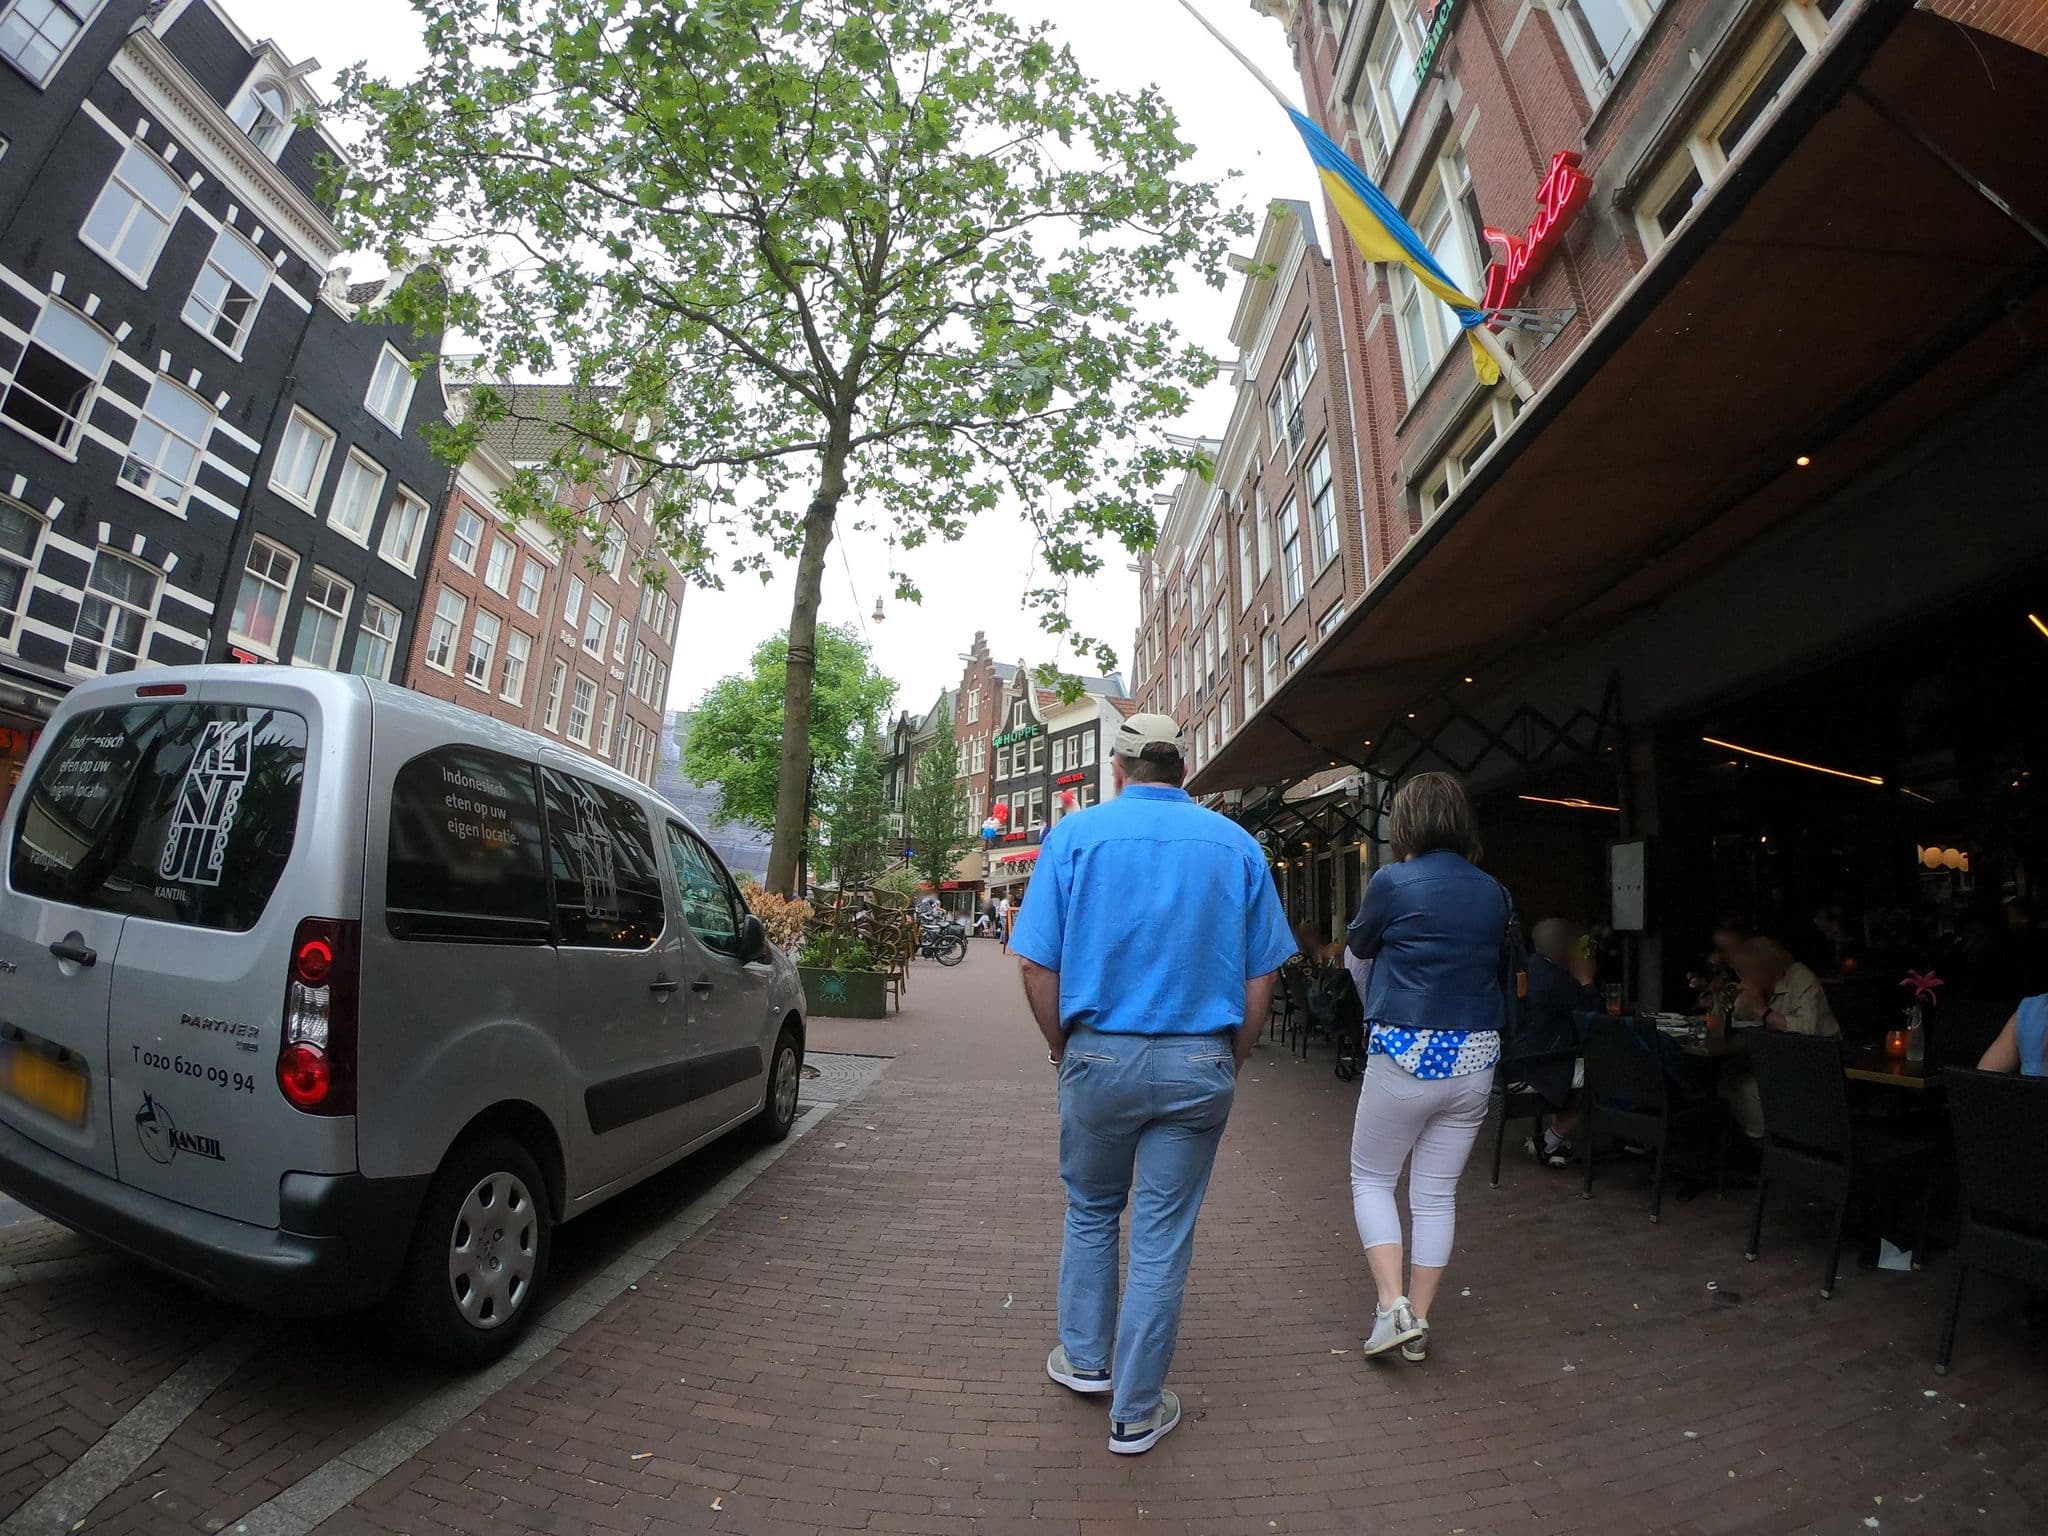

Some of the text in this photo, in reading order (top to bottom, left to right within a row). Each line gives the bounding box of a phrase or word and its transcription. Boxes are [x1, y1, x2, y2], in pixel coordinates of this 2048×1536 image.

[1003, 723, 1039, 745] HOPPE
[59, 759, 111, 773] eten op uw
[442, 766, 507, 798] Indonesisch
[445, 793, 507, 820] eten op uw
[447, 817, 480, 840] eigen
[180, 1012, 260, 1039] PARTNER
[132, 1045, 255, 1095] T 020 620 09 94
